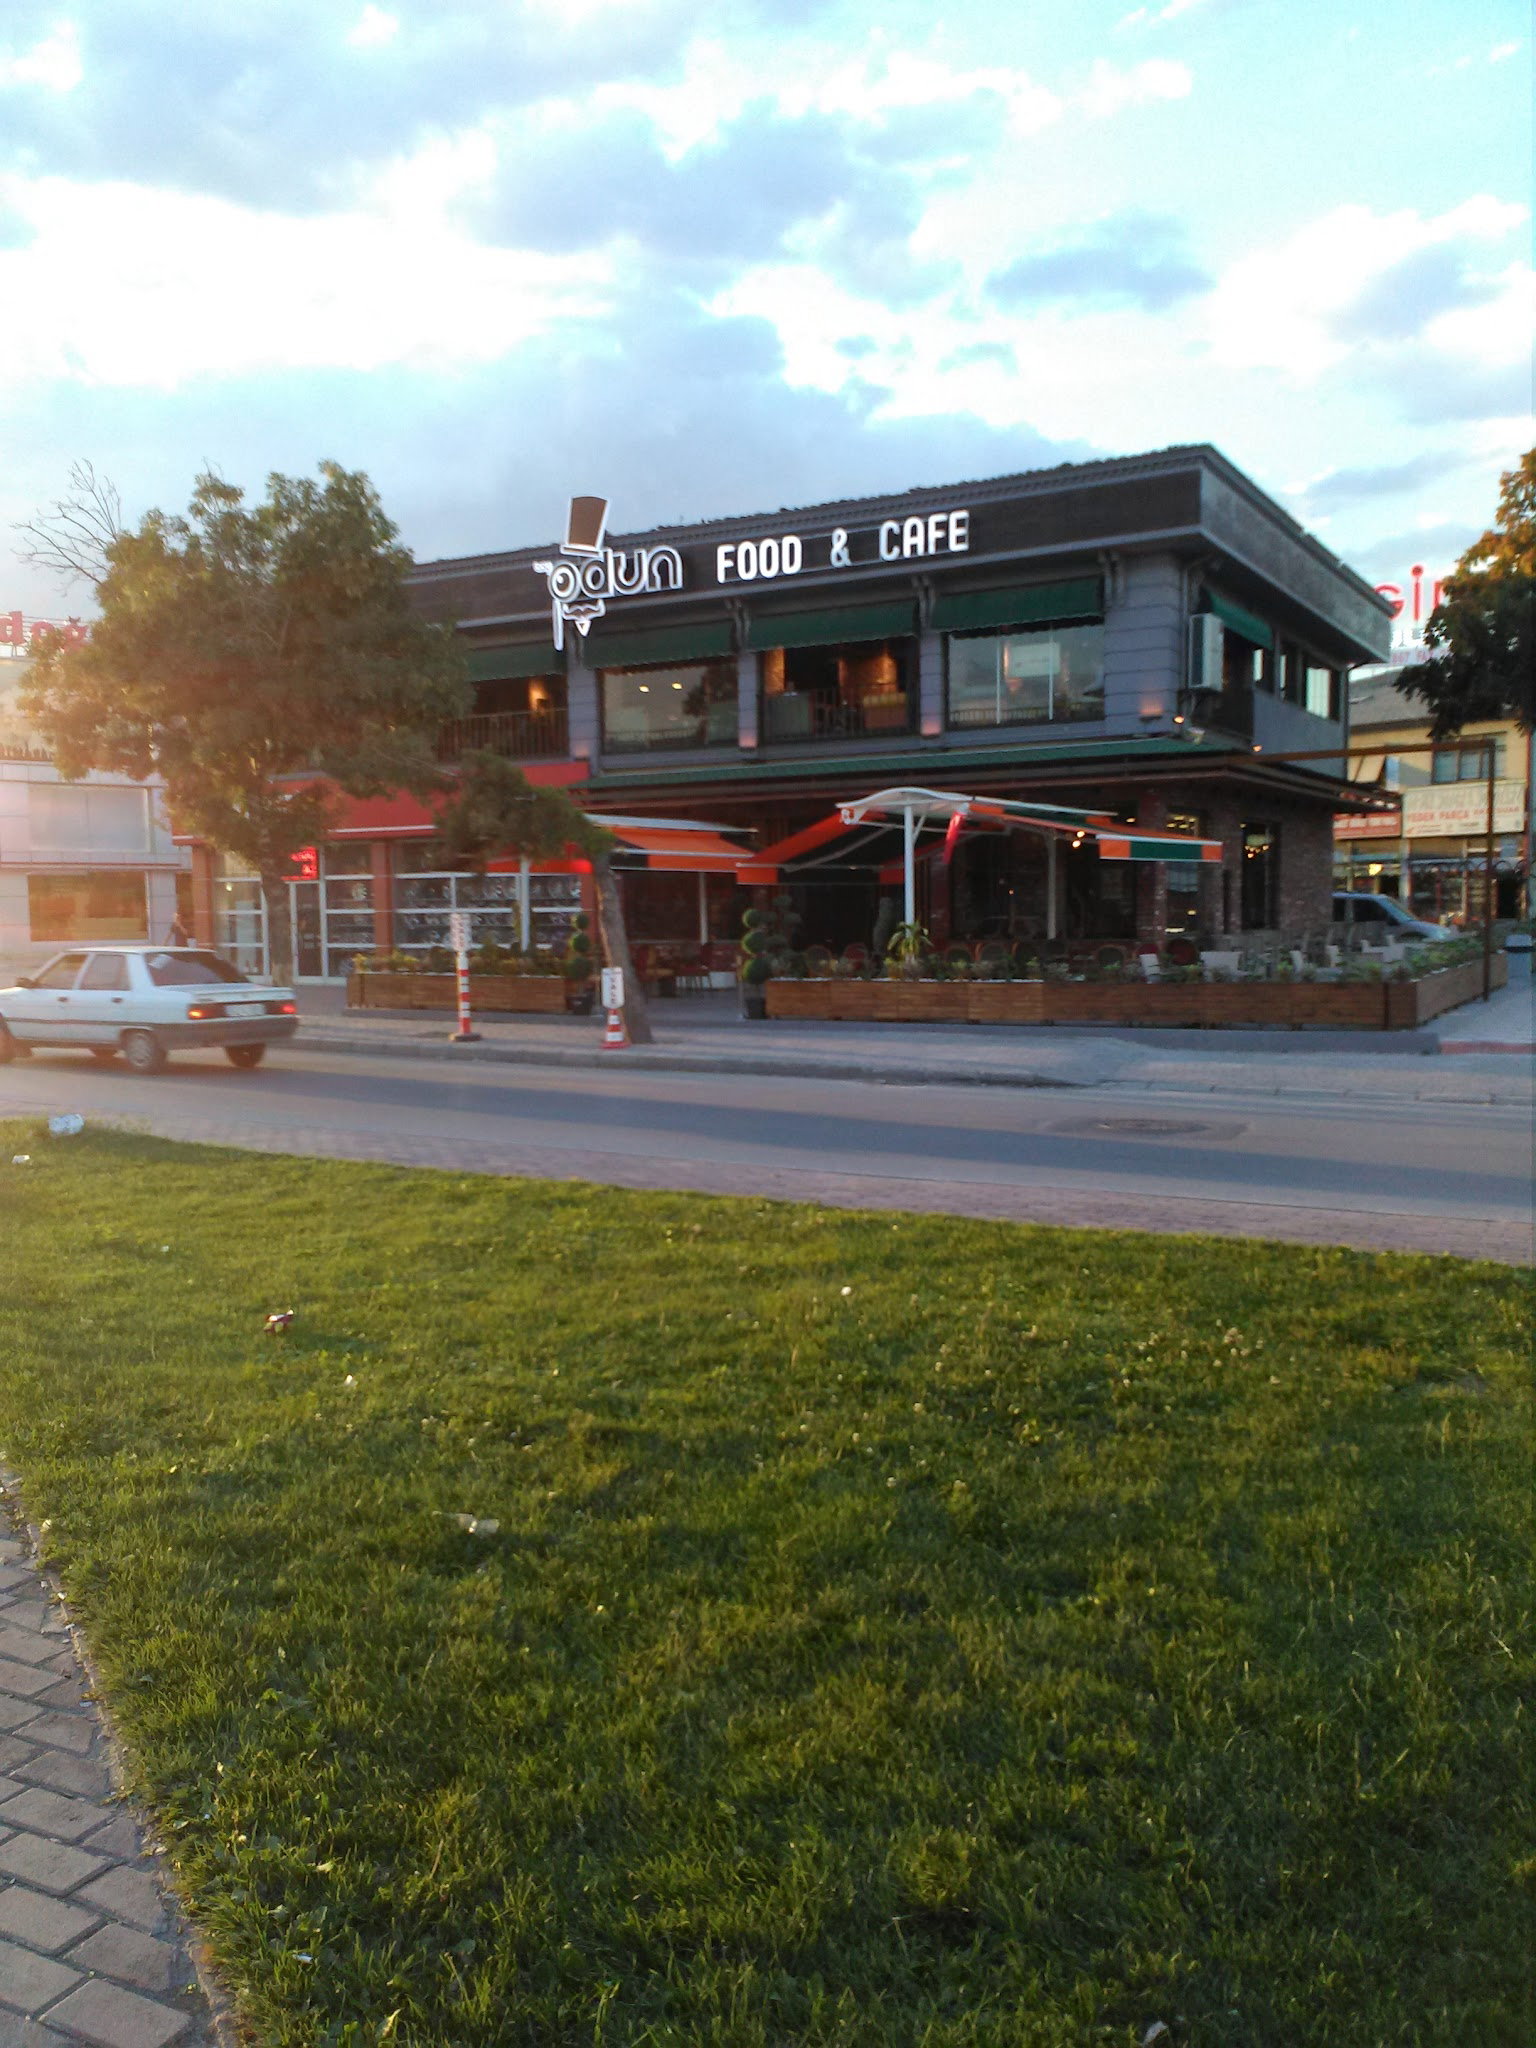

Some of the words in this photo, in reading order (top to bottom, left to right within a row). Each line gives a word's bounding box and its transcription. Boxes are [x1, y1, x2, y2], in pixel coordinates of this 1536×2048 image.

[716, 535, 803, 584] FOOD
[830, 527, 852, 568] &
[879, 509, 970, 562] CAFE
